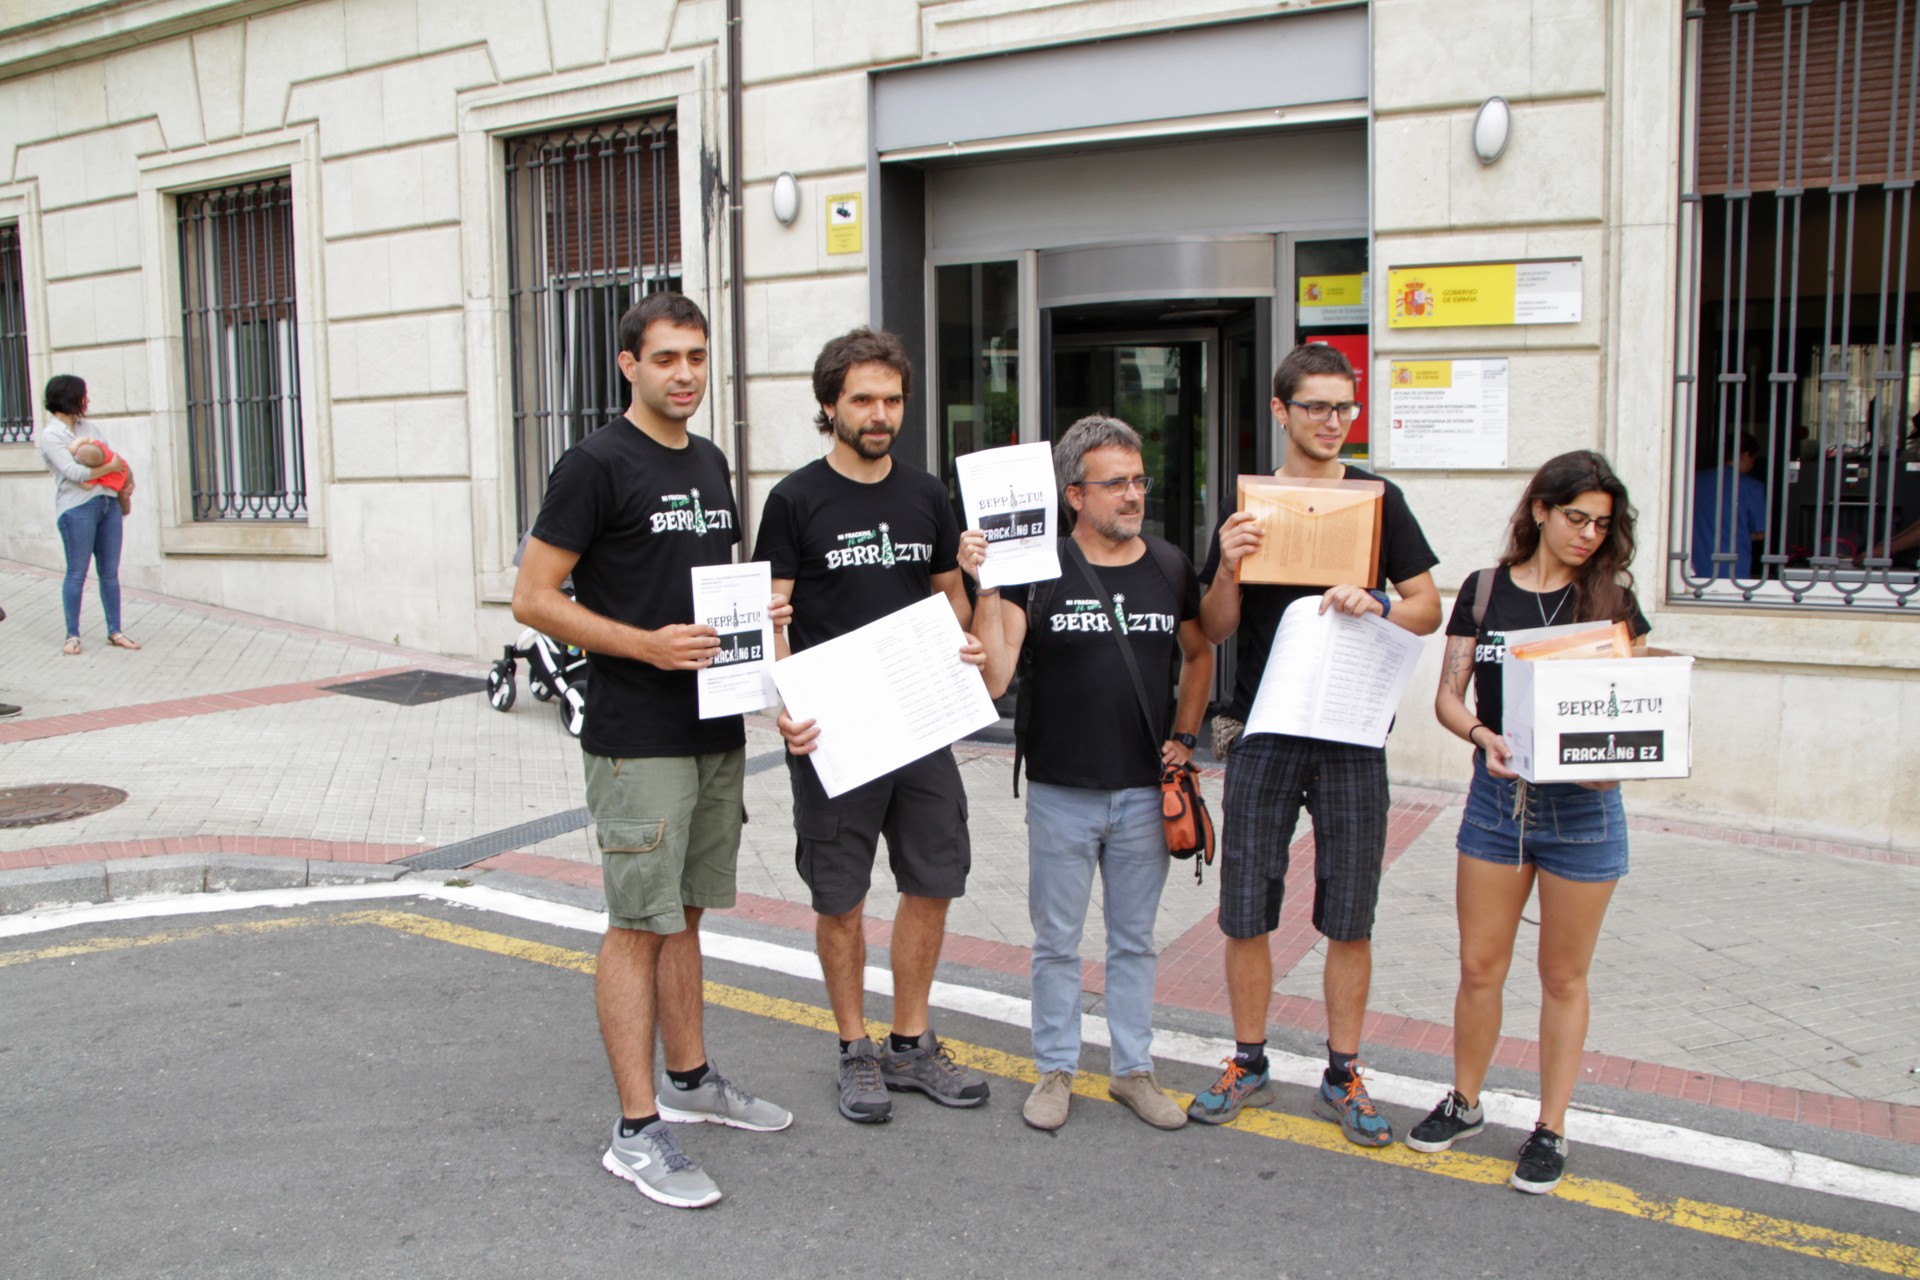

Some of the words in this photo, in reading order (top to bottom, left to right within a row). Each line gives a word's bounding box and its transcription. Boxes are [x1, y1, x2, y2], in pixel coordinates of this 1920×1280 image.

[983, 518, 1028, 541] FRACKING
[1031, 522, 1043, 535] EZ
[751, 645, 761, 658] EZ
[1558, 692, 1662, 717] BERRIZTU!
[1563, 741, 1635, 761] FRACKING
[1640, 746, 1658, 760] EZ
